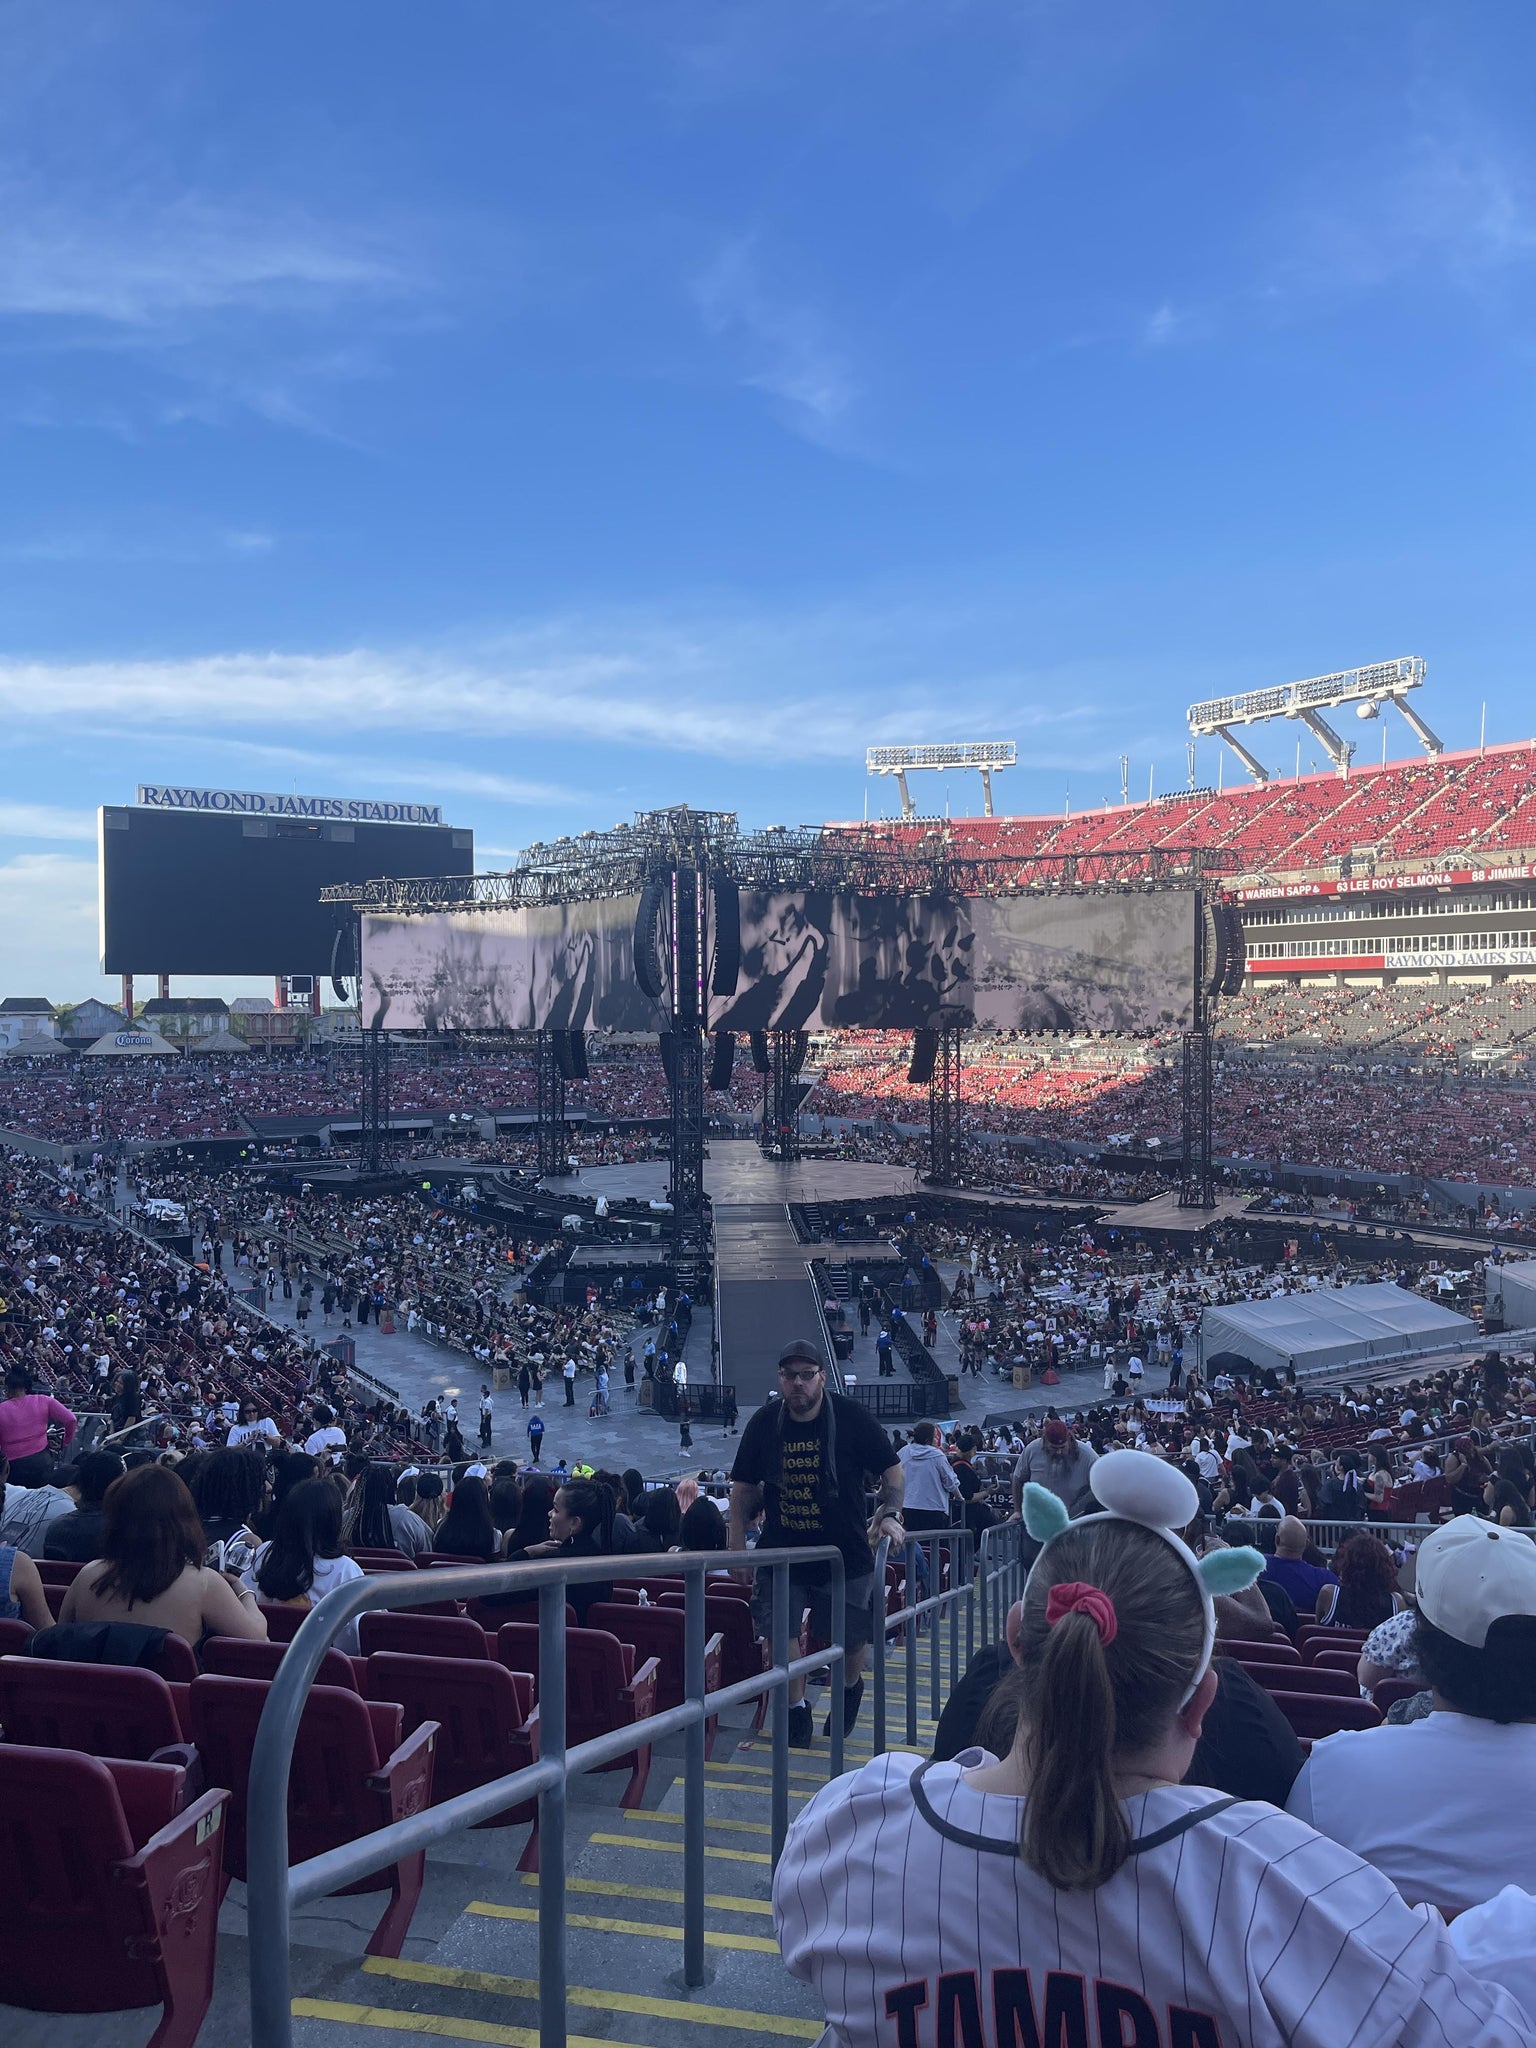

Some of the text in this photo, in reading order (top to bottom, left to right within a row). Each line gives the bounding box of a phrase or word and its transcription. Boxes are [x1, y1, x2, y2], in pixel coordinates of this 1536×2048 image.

[142, 786, 440, 823] RAYMOND JAMES STADIUM
[1471, 870, 1485, 882] 88
[1487, 867, 1530, 880] JIMMIE
[1336, 874, 1443, 892] 63 LEE ROY SELMON
[1245, 887, 1285, 899] WARREN
[1286, 885, 1312, 896] SAPP
[1386, 954, 1456, 968] RAYMOND
[1458, 952, 1506, 966] JAMES
[115, 1035, 152, 1047] Corona
[1047, 1320, 1055, 1329] A
[204, 1811, 213, 1838] R
